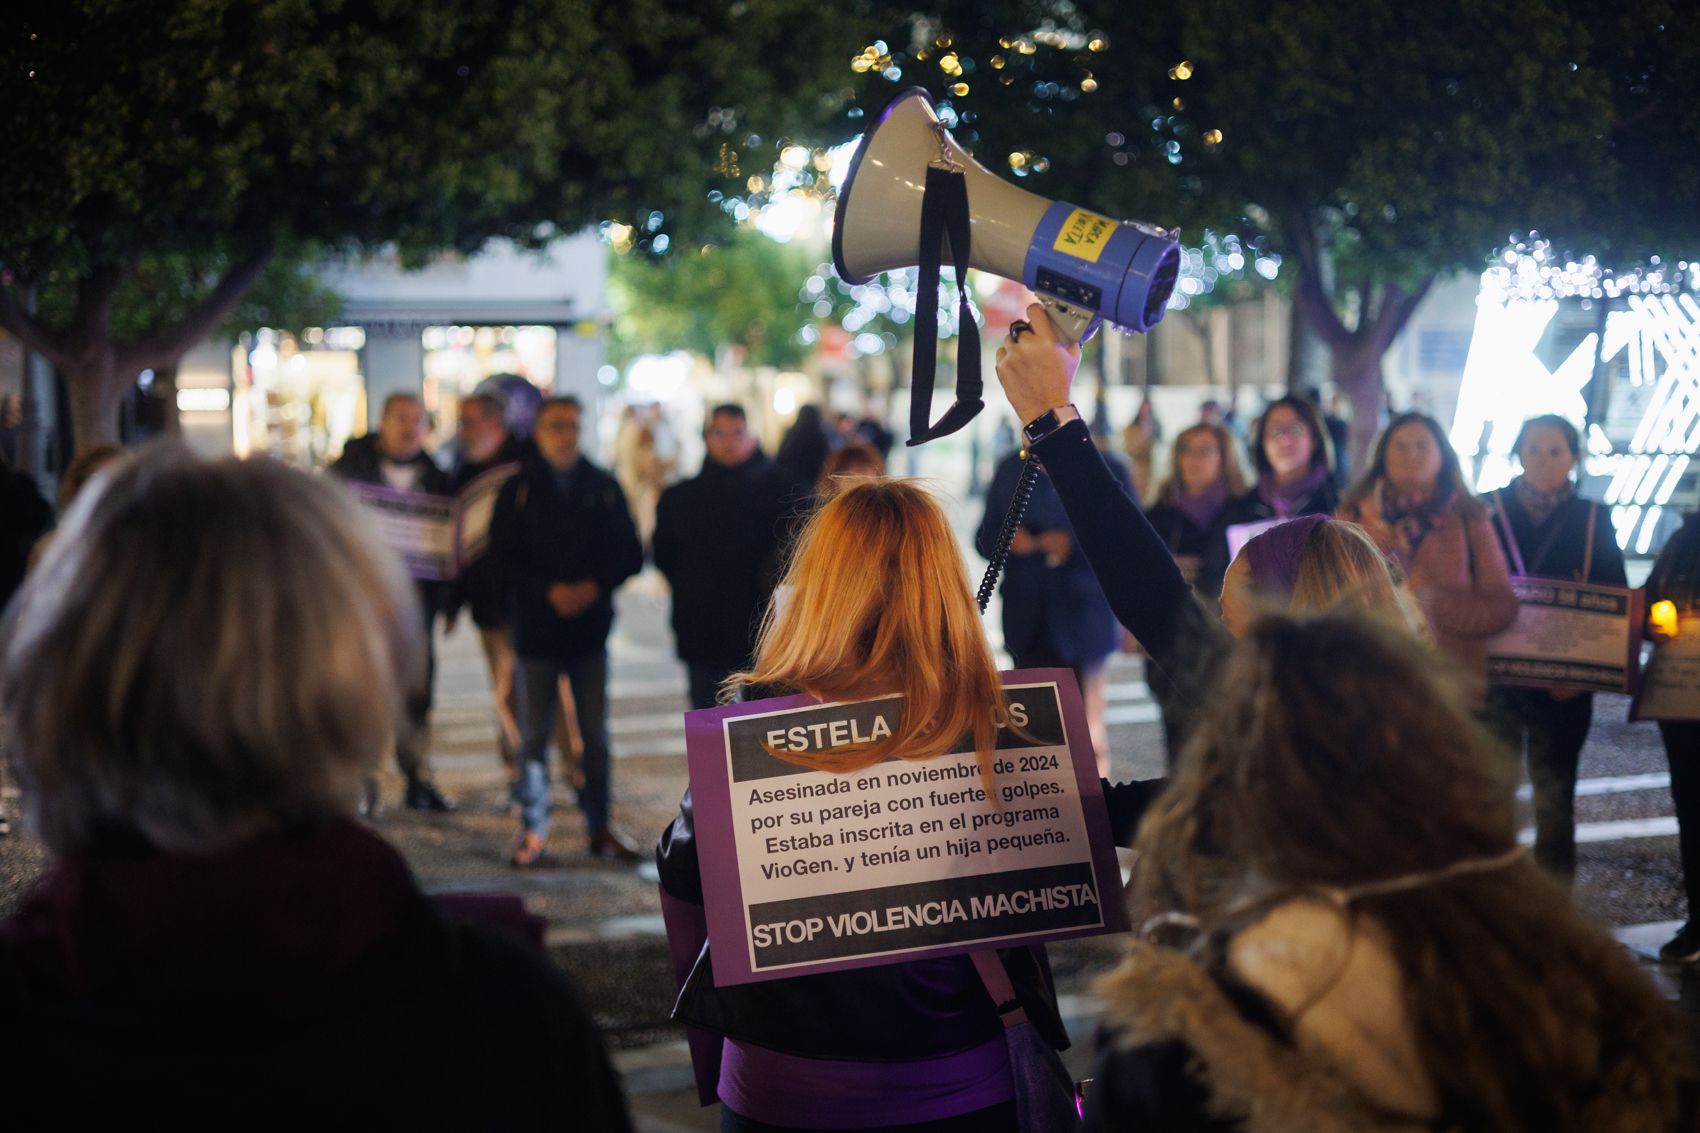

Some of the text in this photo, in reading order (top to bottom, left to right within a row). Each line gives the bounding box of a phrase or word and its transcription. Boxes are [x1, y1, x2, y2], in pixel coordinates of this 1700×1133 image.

[767, 715, 892, 752] ESTELA
[749, 778, 850, 805] Asesinada
[857, 776, 881, 791] en
[993, 758, 1014, 774] de
[1019, 755, 1059, 772] 2024
[751, 781, 1065, 834] por su pareja con fuerte golpes.
[765, 806, 1060, 854] Estaba inscrita en el programa
[761, 828, 1070, 880] VioGen. y tenía un hija pequeña.
[753, 883, 1098, 948] STOP VIOLENCIA MACHISTA
